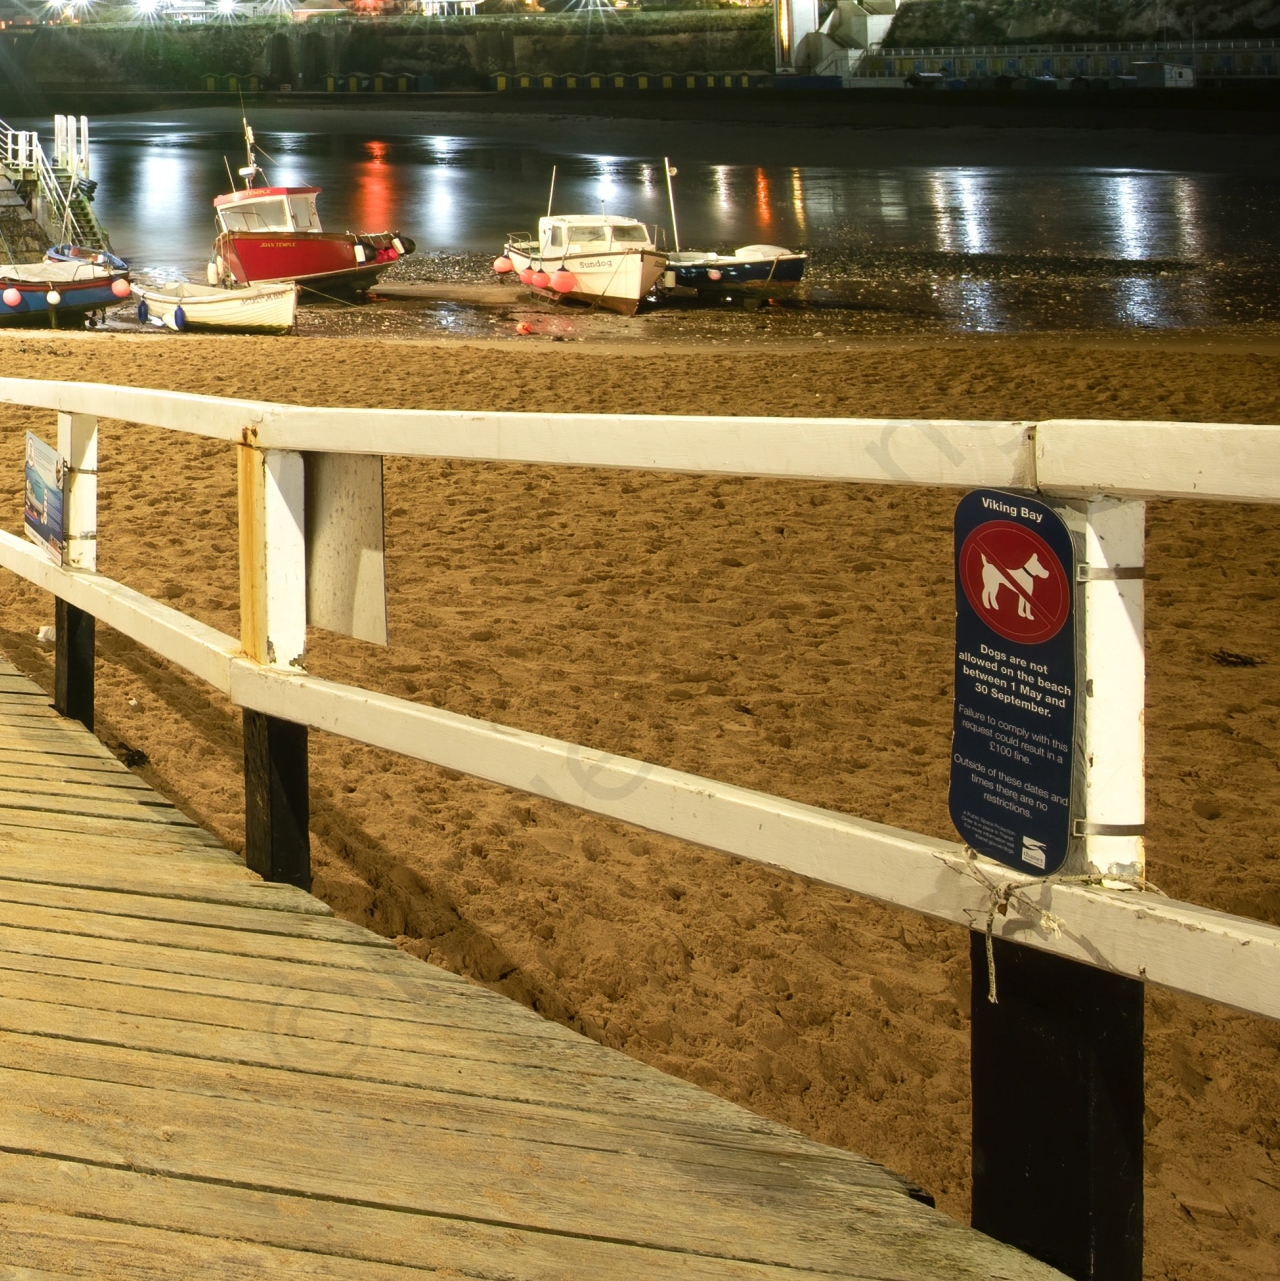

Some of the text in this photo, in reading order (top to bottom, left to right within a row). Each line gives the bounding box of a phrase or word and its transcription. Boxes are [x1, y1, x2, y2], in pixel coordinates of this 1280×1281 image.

[579, 259, 613, 269] Sundog
[981, 496, 1044, 524] Viking Bay
[958, 651, 1072, 696] allowed on the beach
[980, 643, 1049, 675] Dogs are not
[963, 664, 1066, 708] between 1 May and
[975, 682, 1052, 717] 30 September.
[958, 703, 1068, 753] Failure to comply with this
[962, 719, 1064, 764] request could result in a
[989, 741, 1032, 766] £100 fine.
[953, 753, 1068, 807] Outside of these dates and
[971, 773, 1048, 812] times there are no
[983, 791, 1033, 819] restrictions.
